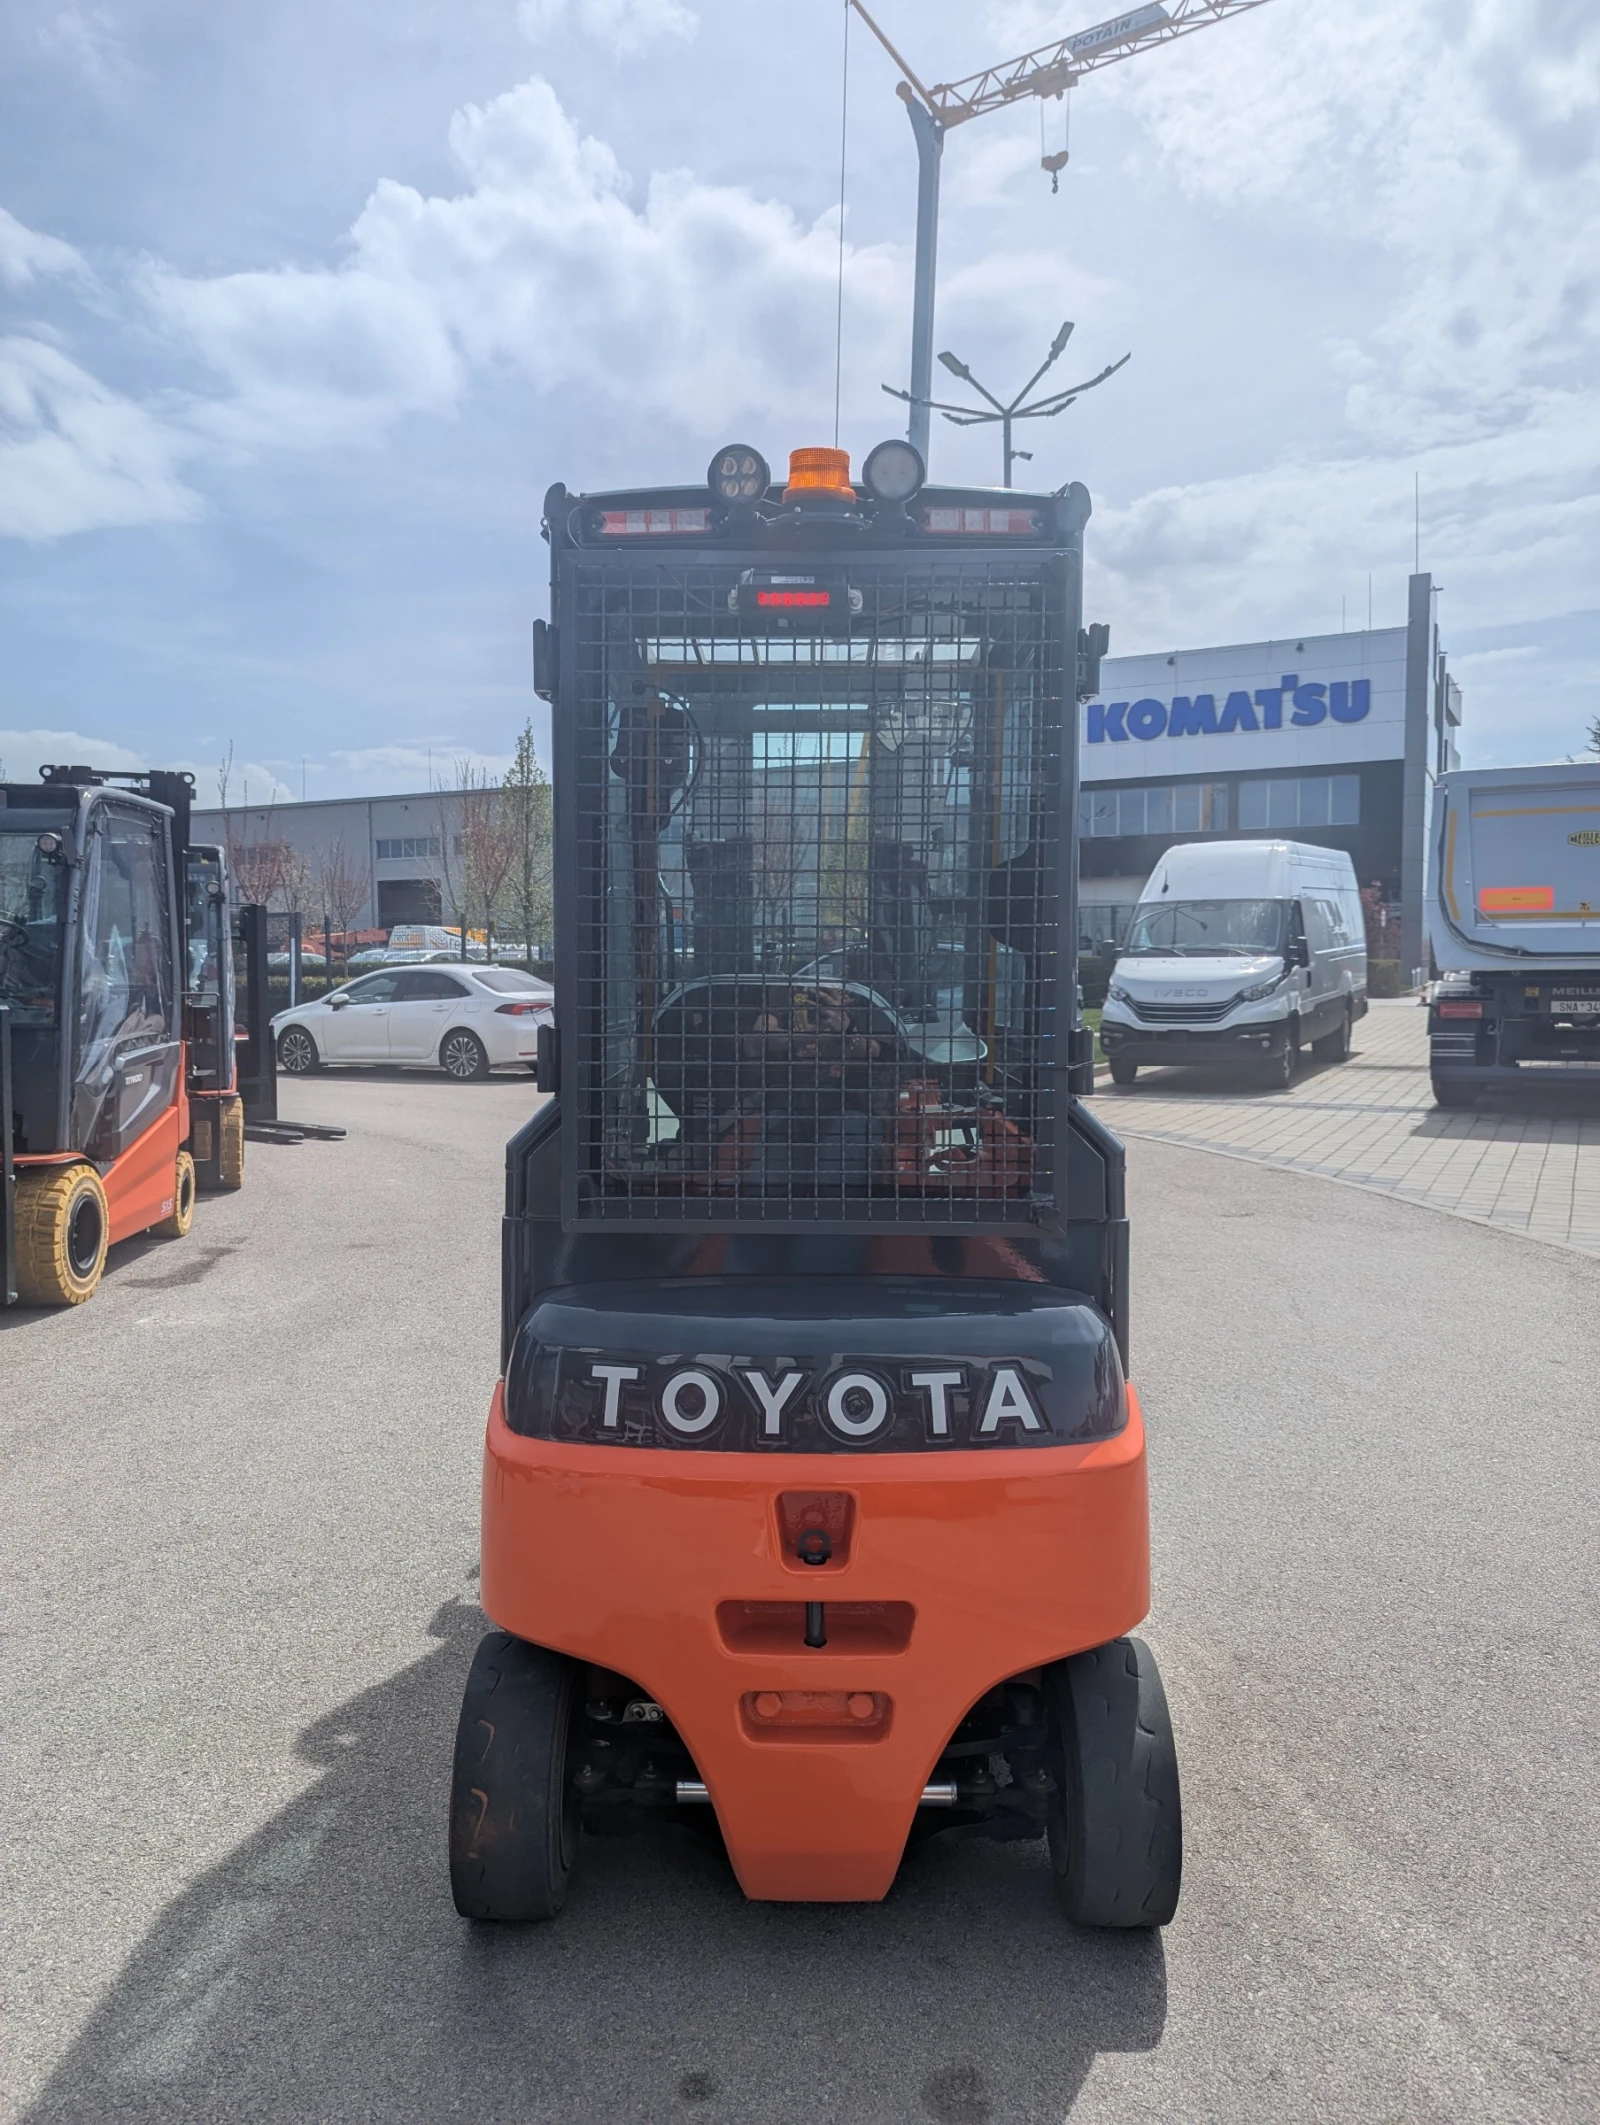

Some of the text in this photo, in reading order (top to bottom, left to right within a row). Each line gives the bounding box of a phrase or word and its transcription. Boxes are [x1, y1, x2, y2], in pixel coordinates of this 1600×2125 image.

[1071, 19, 1131, 51] POTAIN
[1087, 674, 1371, 744] KOMATSU
[1154, 988, 1208, 998] IVECO
[591, 1365, 1041, 1436] TOYOTA
